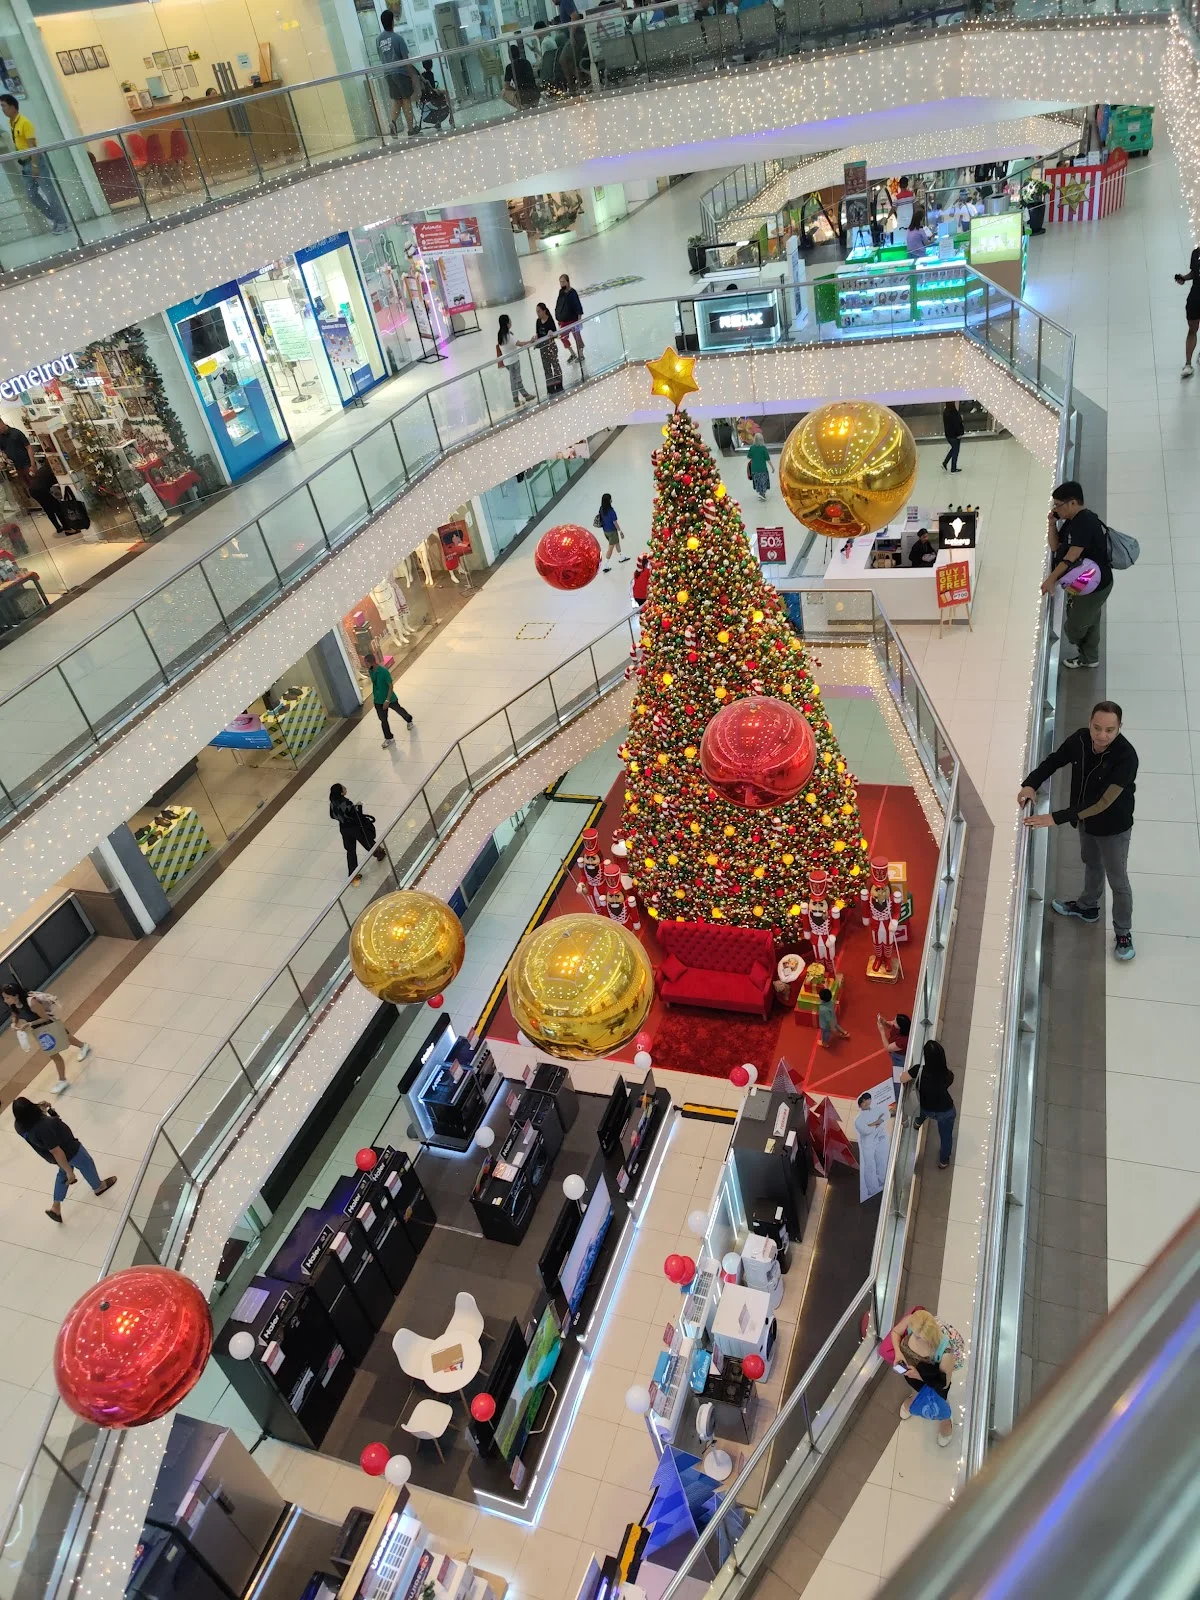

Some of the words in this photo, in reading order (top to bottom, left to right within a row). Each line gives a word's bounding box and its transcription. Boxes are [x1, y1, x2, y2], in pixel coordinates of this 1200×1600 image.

[939, 567, 959, 578] BUY
[940, 573, 959, 584] GET
[940, 579, 967, 592] FREE
[372, 1162, 386, 1182] Haier
[347, 1193, 361, 1214] Haier
[305, 1245, 321, 1268] Haier
[263, 1314, 280, 1339] Haier
